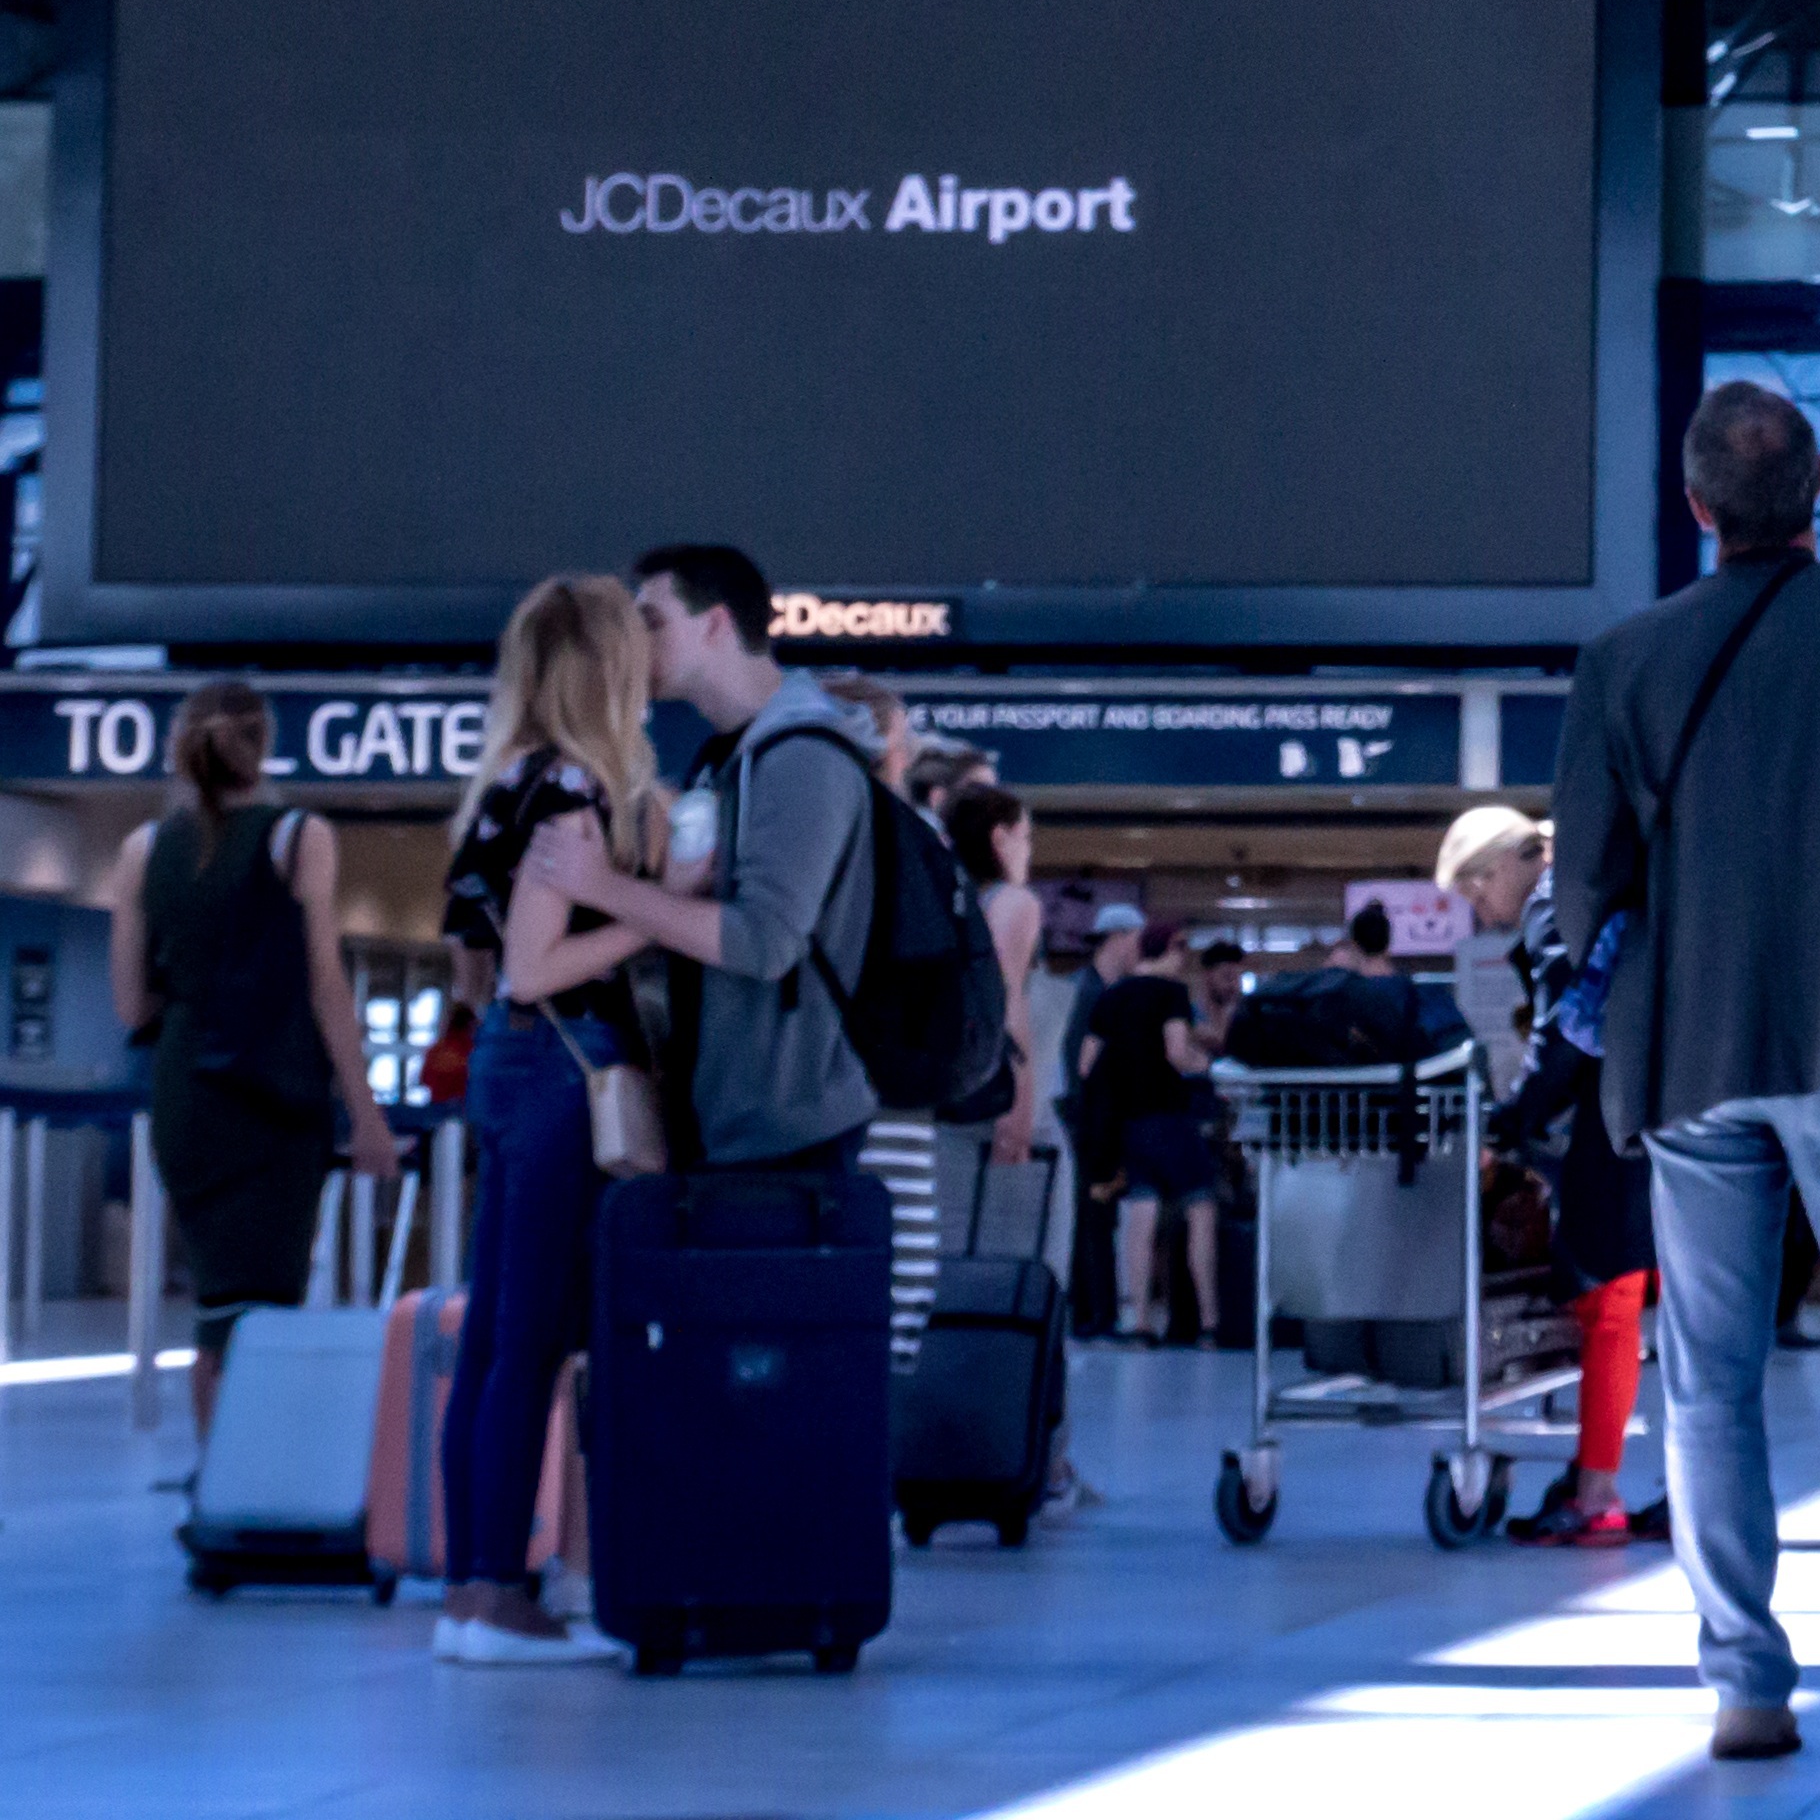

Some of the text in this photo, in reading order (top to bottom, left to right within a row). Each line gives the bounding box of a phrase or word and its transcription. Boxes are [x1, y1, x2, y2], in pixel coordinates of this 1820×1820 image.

[559, 173, 1137, 246] JCDecaux Airport
[54, 699, 156, 776] TO
